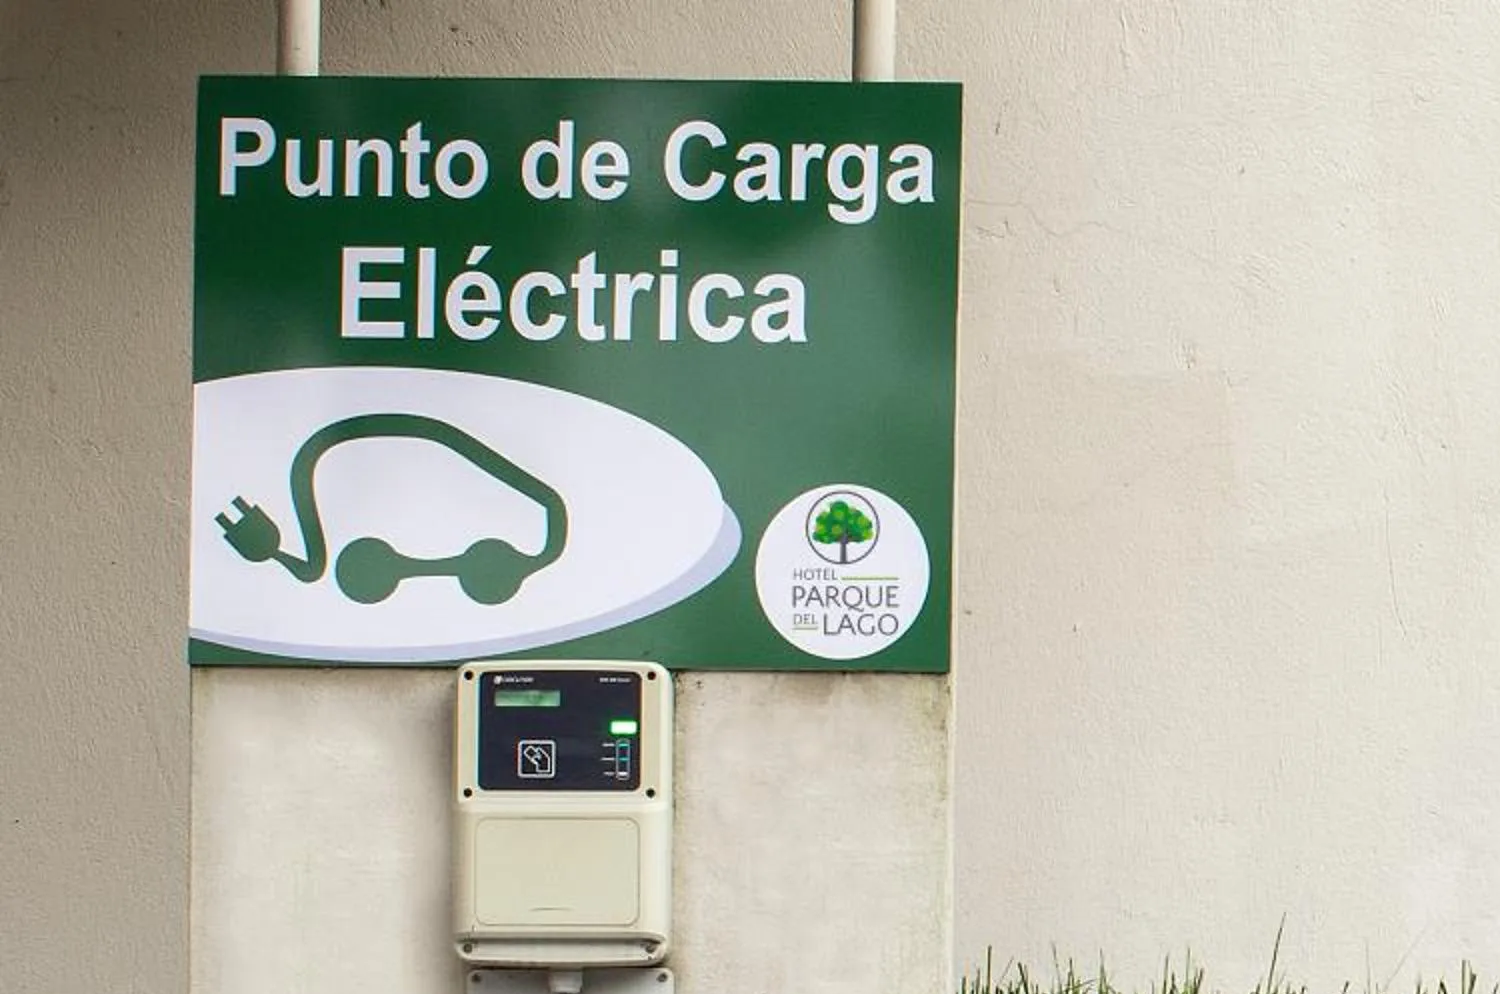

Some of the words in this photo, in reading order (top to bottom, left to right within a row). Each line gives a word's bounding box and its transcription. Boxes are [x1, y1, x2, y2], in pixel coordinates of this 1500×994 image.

[220, 117, 489, 200] Punto
[521, 120, 630, 201] de
[664, 121, 935, 224] Carga
[340, 245, 807, 343] Eléctrica
[793, 568, 838, 580] HOTEL
[792, 585, 900, 612] PARQUE
[793, 614, 817, 625] DEL
[823, 613, 899, 636] LAGO
